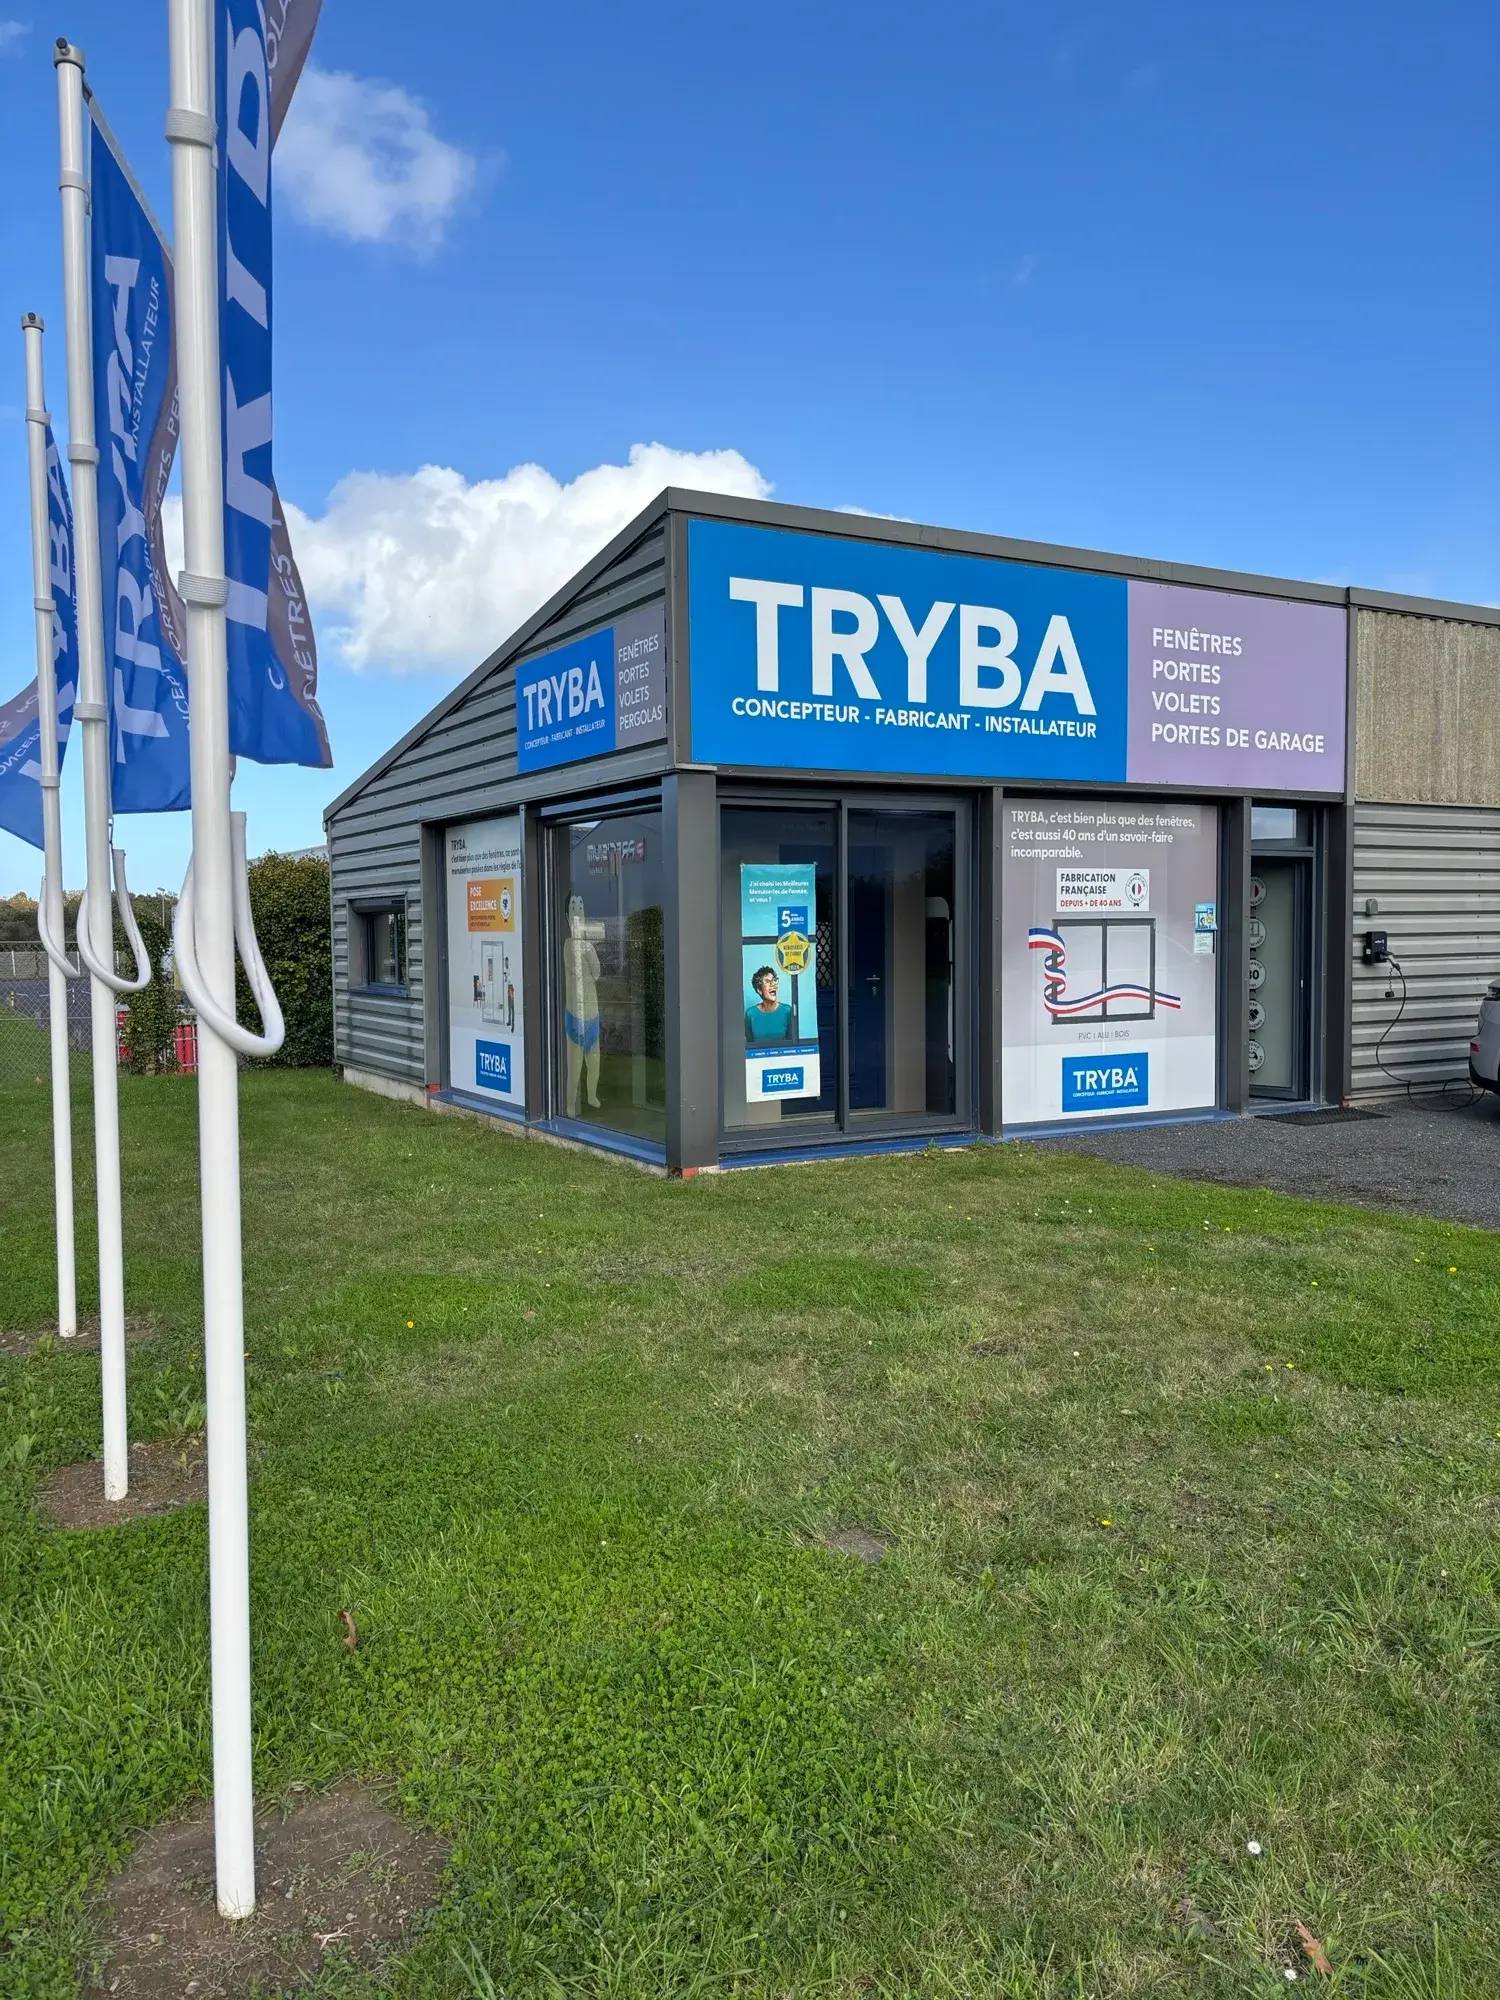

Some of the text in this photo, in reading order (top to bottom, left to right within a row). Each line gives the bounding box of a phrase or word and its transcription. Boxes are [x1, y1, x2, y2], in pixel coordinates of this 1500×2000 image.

[133, 276, 160, 448] INSTALLATEUR
[618, 634, 659, 663] FENÊTRES
[729, 577, 1097, 716] TRYBA
[1152, 627, 1242, 656] FENÊTRES
[618, 662, 650, 686] PORTES
[1152, 659, 1221, 684] PORTES
[523, 660, 605, 731] TRYBA
[618, 685, 650, 709] VOLETS
[1152, 691, 1221, 715] VOLETS
[619, 704, 663, 731] PERGOLAS
[732, 697, 860, 723] CONCEPTEUR
[875, 708, 971, 731] FABRICANT
[985, 716, 1097, 738] INSTALLATEUR
[1152, 723, 1325, 753] PORTES DE GARAGE
[1011, 810, 1195, 828] TRYBA, c'est bien plus que des fenêtres,
[1011, 828, 1174, 843] c'est aussi 40 ans d'un savoir-faire
[1010, 846, 1083, 860] incomparable.
[1060, 873, 1116, 882] FABRICATION
[1060, 885, 1107, 897] FRANÇAISE
[781, 910, 791, 928] 5
[1078, 1032, 1091, 1040] PVC
[1098, 1031, 1109, 1039] ALU
[1115, 1030, 1130, 1038] BOIS
[480, 1052, 507, 1074] TRYBA
[767, 1073, 799, 1084] TRYBA
[1073, 1067, 1138, 1090] TRYBA
